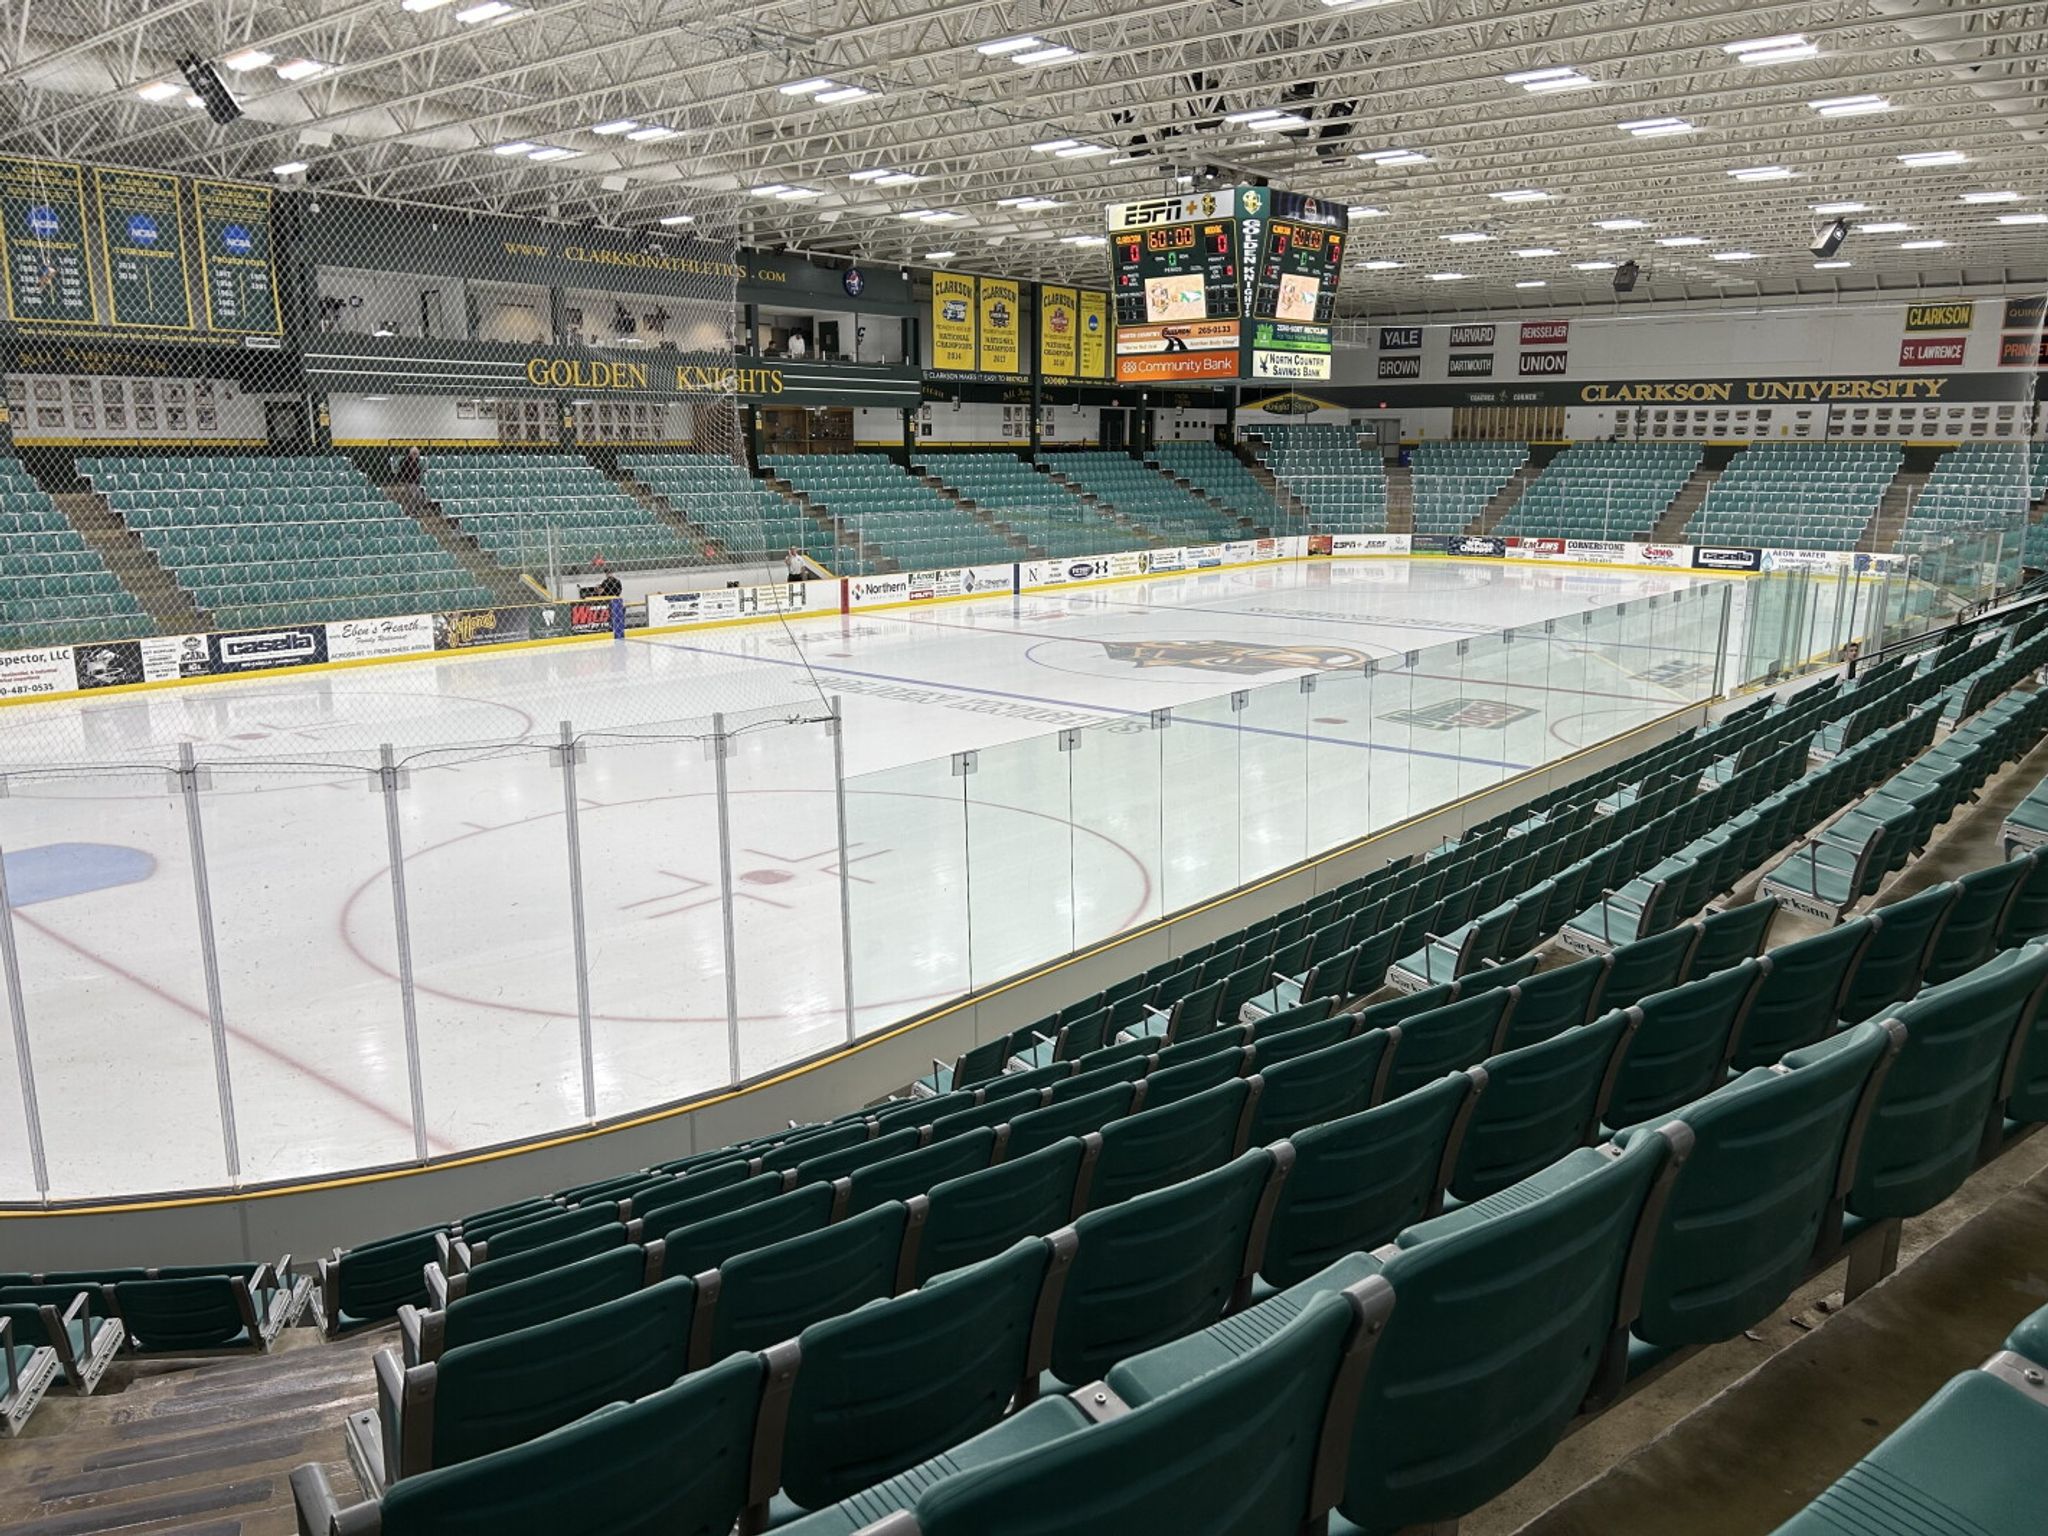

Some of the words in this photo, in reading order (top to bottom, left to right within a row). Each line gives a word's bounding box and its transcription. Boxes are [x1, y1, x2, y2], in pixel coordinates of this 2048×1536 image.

[131, 229, 157, 239] NCAA
[1149, 227, 1193, 248] 60:00
[1242, 219, 1261, 264] GOLDEN
[226, 239, 251, 248] NCAA
[935, 280, 973, 299] CLARKSON
[982, 286, 1016, 303] CLARKSON
[1243, 266, 1255, 317] KNIGHTS
[1909, 307, 1970, 325] CLARKSON
[939, 333, 970, 342] NATIONAL
[1384, 330, 1419, 346] YALE
[1450, 327, 1494, 343] HARVARD
[1522, 325, 1567, 339] RENSSELAER
[935, 341, 973, 350] CHAMPIONS
[1902, 347, 1915, 360] ST.
[1917, 345, 1962, 359] LAWRENCE
[1138, 360, 1200, 373] Community
[1203, 357, 1232, 370] Bank
[1269, 353, 1292, 364] NORTH
[1294, 355, 1324, 366] COUNTRY
[1379, 359, 1420, 375] BROWN
[1450, 359, 1491, 373] DARTMOUTH
[1520, 355, 1566, 372] UNION
[527, 358, 648, 389] GOLDEN
[675, 365, 784, 394] KNIGHTS
[929, 372, 958, 380] CLARKSON
[1273, 365, 1301, 377] SAVINGS
[1303, 367, 1320, 377] BANK
[1581, 383, 1733, 401] CLARKSON
[1746, 378, 1948, 401] UNIVERSITY
[1567, 540, 1625, 551] CORNERSTONE
[1772, 549, 1795, 557] AEON
[865, 582, 907, 595] Northern
[342, 621, 378, 638] Eben's
[380, 619, 419, 633] Hearth
[227, 634, 313, 656] casella
[50, 650, 70, 662] LLC
[1763, 887, 1831, 921] Crkson
